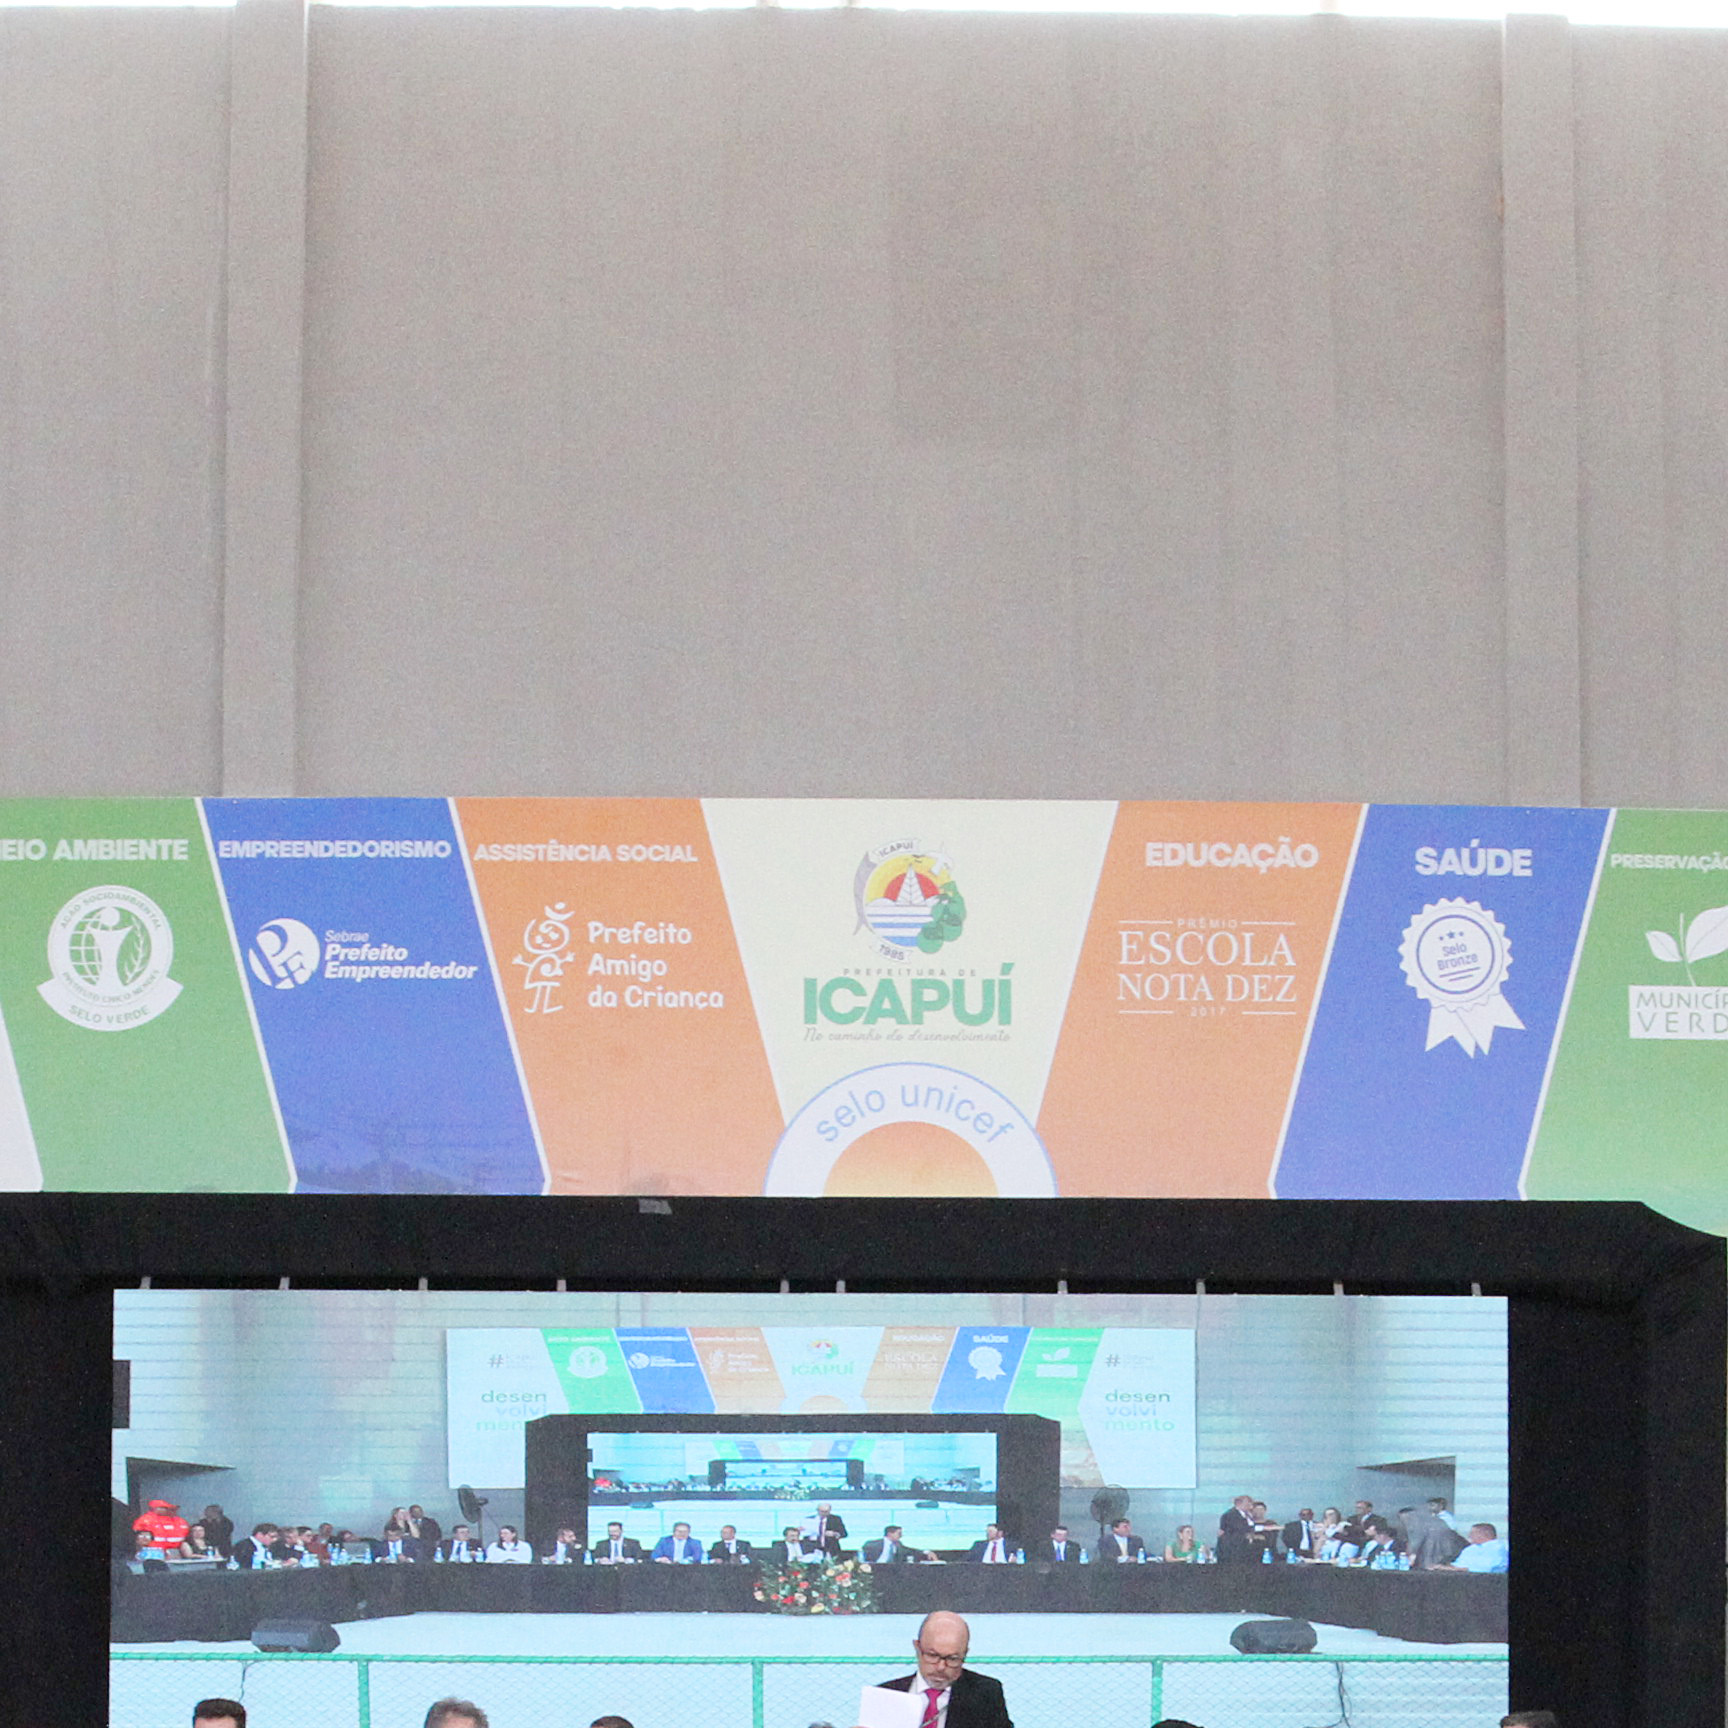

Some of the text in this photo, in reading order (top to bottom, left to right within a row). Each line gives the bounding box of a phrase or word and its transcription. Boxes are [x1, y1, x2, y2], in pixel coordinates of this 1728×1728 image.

[53, 839, 189, 861] AMBIENTE
[219, 840, 452, 859] EMPREENDEDORISMO
[474, 839, 698, 863] ASSISTÊNCIA SOCIAL
[1145, 835, 1319, 876] EDUCAÇÃO
[1415, 838, 1533, 877] SAÚDE
[588, 922, 692, 945] Prefeito
[1178, 918, 1238, 928] PRÊMIO
[325, 930, 369, 943] Sebrae
[325, 943, 408, 962] Prefeito
[1119, 931, 1297, 966] ESCOLA
[325, 961, 478, 981] Empreendedor
[588, 953, 668, 982] Amigo
[843, 968, 947, 977] PREFEITURA
[588, 985, 724, 1010] da Criança
[803, 962, 1015, 1026] ICAPUÍ
[1117, 973, 1297, 1002] NOTA DEZ
[69, 1004, 152, 1024] SELO VERDE
[817, 1083, 1015, 1144] selo unicef
[481, 1389, 547, 1404] desen
[1105, 1389, 1171, 1403] desen
